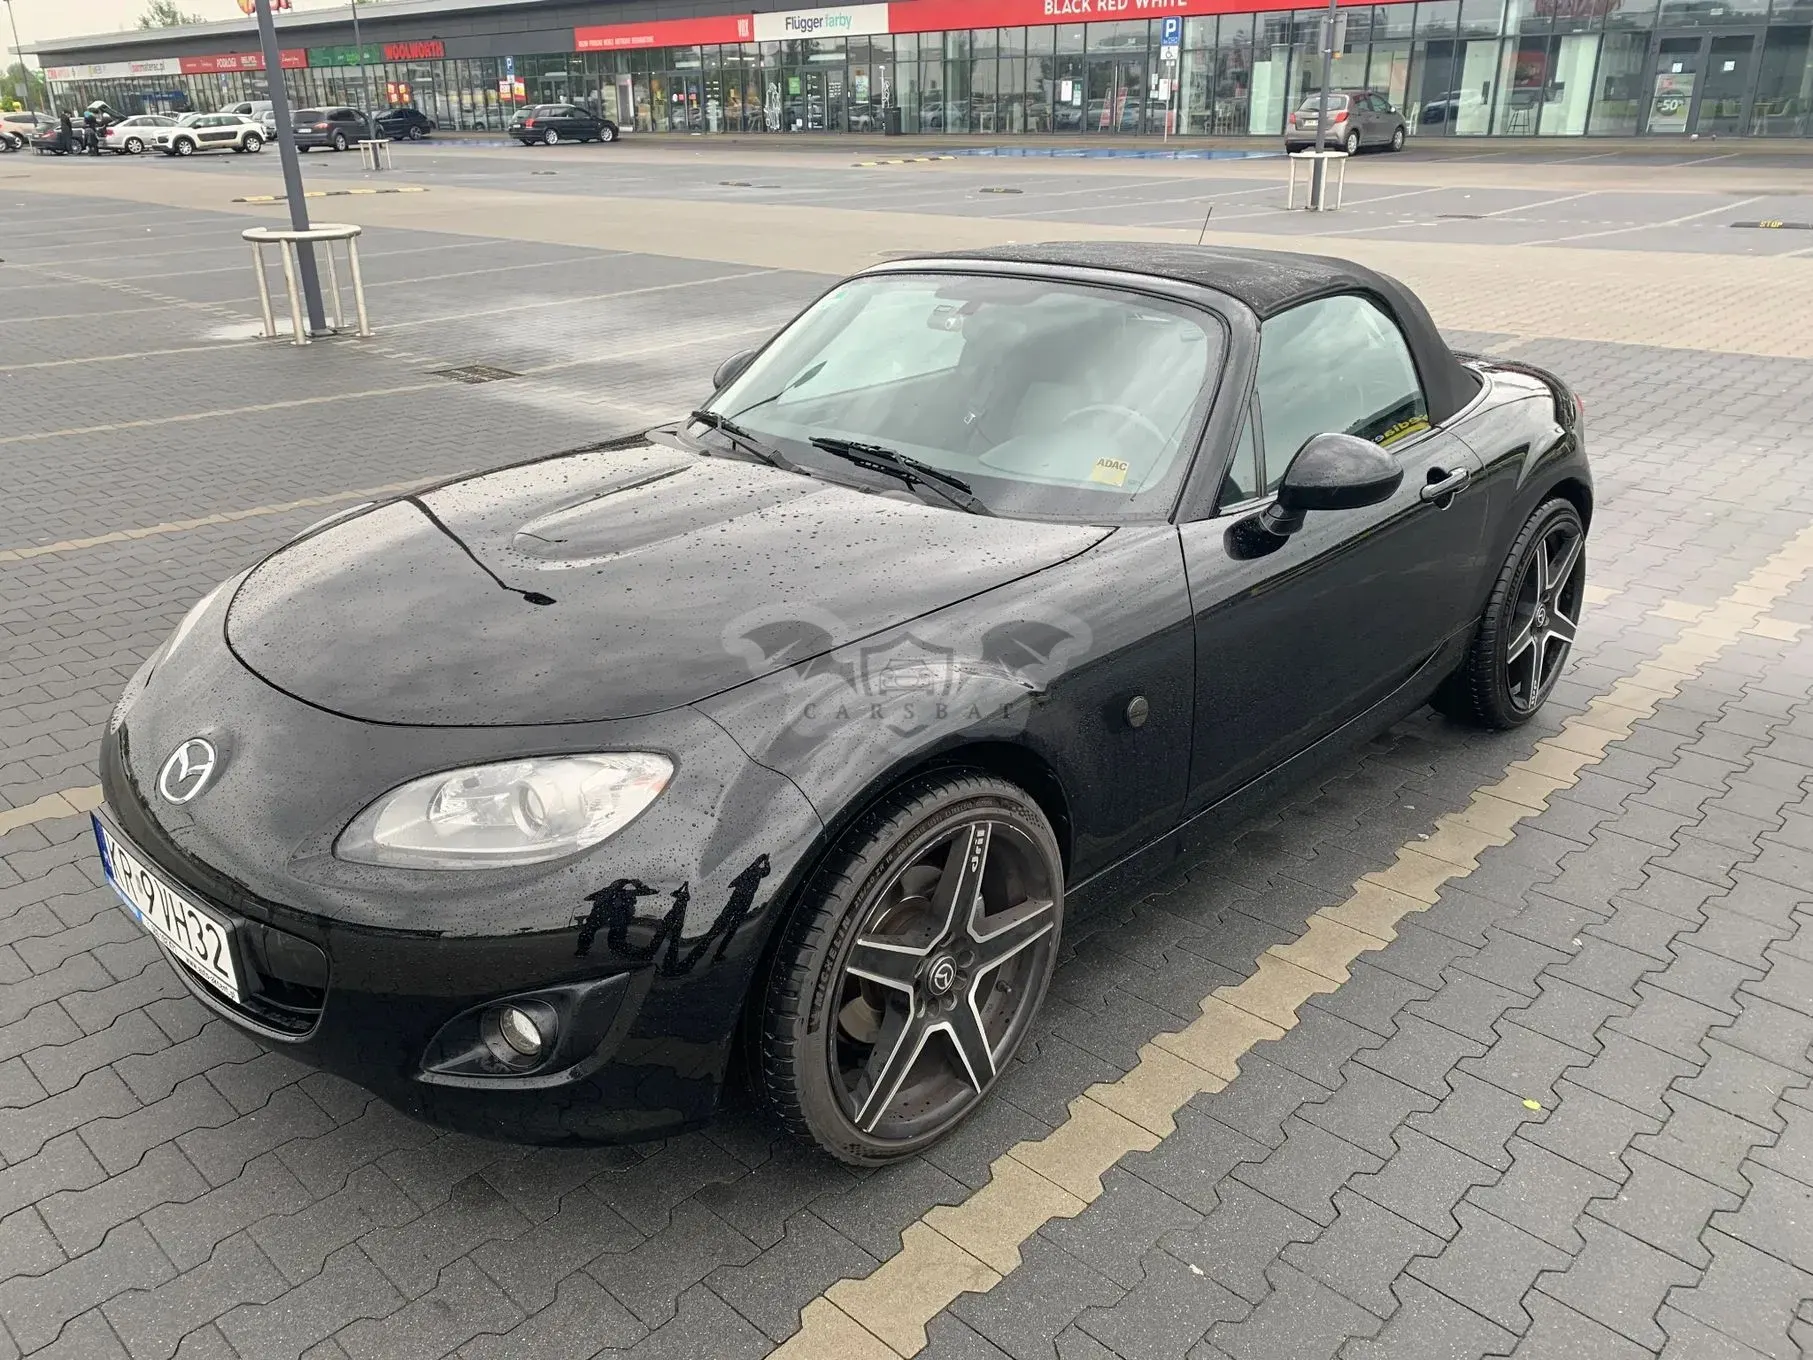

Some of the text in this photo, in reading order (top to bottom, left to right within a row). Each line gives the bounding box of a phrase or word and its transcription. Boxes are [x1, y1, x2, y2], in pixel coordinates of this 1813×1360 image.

[1044, 0, 1092, 15] BLACK
[1097, 0, 1128, 12] RED
[785, 13, 852, 32] Flügger farby
[1165, 19, 1177, 38] P
[384, 41, 445, 60] WOOLWORTH
[1096, 458, 1128, 471] ADAC
[105, 833, 138, 902] KR
[140, 869, 229, 979] 9VH32
[814, 915, 851, 1008] MICHELIN
